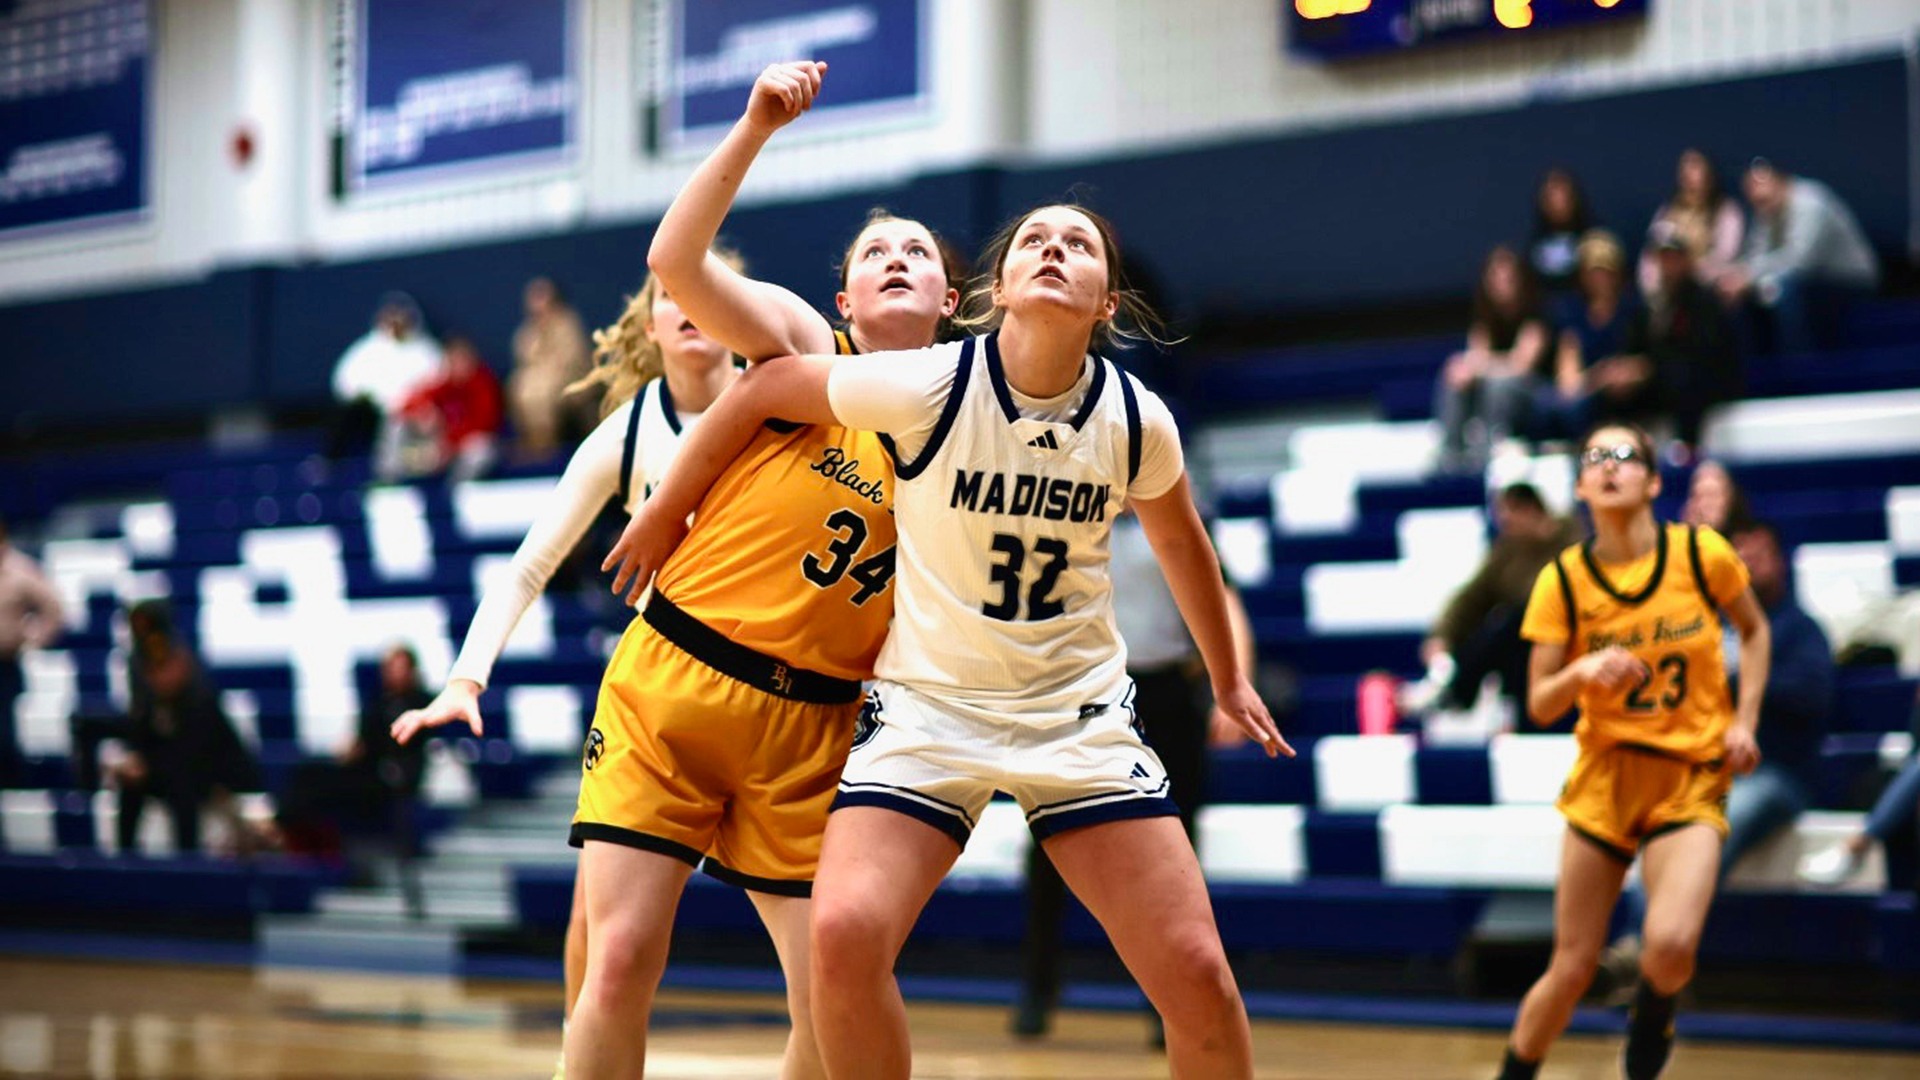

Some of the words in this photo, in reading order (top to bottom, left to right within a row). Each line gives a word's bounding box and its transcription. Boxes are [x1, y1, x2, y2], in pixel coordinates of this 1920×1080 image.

[809, 447, 884, 504] Black
[950, 469, 1111, 523] MADISON
[801, 508, 896, 607] 34
[981, 531, 1069, 621] 32
[1624, 652, 1689, 710] 23
